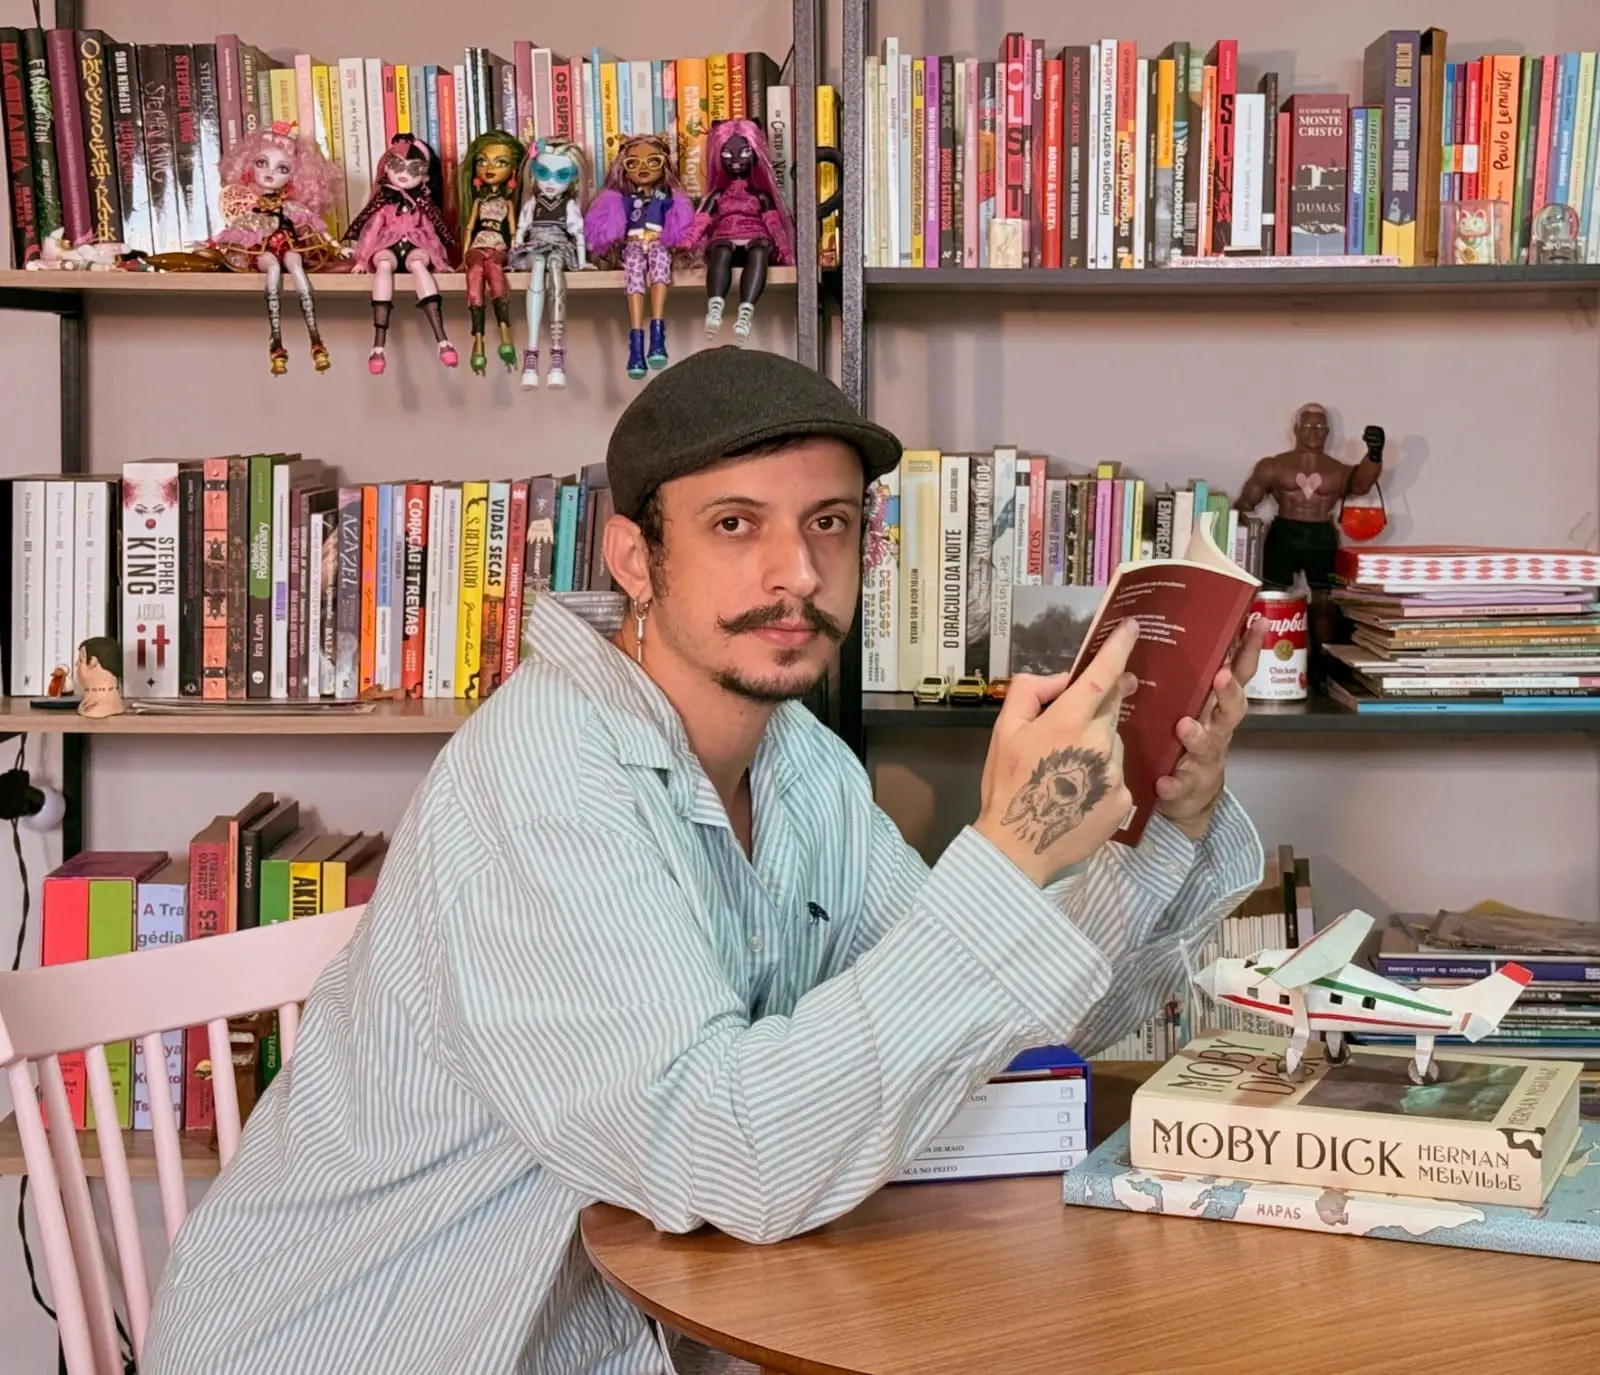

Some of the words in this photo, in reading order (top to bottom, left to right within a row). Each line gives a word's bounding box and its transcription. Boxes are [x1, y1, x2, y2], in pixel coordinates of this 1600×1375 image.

[115, 51, 127, 73] KING
[1103, 47, 1115, 91] uketsu
[117, 74, 132, 115] STEPHEN
[176, 55, 192, 108] STEPHEN
[555, 72, 569, 92] OS
[714, 83, 725, 91] O
[984, 77, 992, 97] ROSA
[1496, 69, 1513, 125] Leminski
[28, 58, 53, 144] FRANKENSTEIN
[144, 83, 168, 139] STEPHEN
[178, 112, 194, 143] KING
[1101, 93, 1114, 158] estranhas
[1298, 126, 1342, 137] CRISTO
[1299, 115, 1342, 126] MONTE
[150, 143, 171, 183] KING
[941, 148, 952, 182] SONHOS
[1046, 146, 1057, 181] ROMEU
[1119, 139, 1131, 175] NELSON
[1173, 139, 1186, 179] NELSON
[1492, 128, 1511, 170] Paulo
[1070, 193, 1080, 216] MARIA
[1099, 160, 1112, 216] imagens
[1045, 192, 1057, 231] JULIETA
[1118, 176, 1131, 237] RODRIGUES
[1172, 181, 1186, 238] RODRIGUES
[1296, 203, 1341, 213] DUMAS
[23, 492, 33, 510] Elena
[55, 492, 64, 510] Elena
[975, 465, 991, 504] DONNA
[23, 511, 32, 539] Ferrante
[55, 511, 64, 538] Ferrante
[405, 497, 425, 563] CORAÇÃO
[489, 499, 505, 542] VIDAS
[974, 506, 990, 559] HARAWAY
[1154, 500, 1173, 560] EMPRECA
[256, 521, 271, 582] Rosemary
[339, 513, 360, 589] AZAZEL
[463, 527, 479, 588] BERNARDO
[943, 529, 960, 562] NOITE
[1029, 530, 1041, 575] MITOS
[24, 556, 32, 583] História
[126, 536, 157, 596] KING
[158, 536, 176, 596] STEPHEN
[487, 545, 503, 586] SECAS
[509, 562, 520, 597] HOMEM
[943, 564, 960, 581] DA
[998, 555, 1010, 573] Ser
[405, 572, 421, 635] TREVAS
[879, 569, 892, 638] DEVASSOS
[909, 568, 919, 605] MITOLOGIA
[136, 604, 143, 621] A
[143, 604, 166, 621] COISA
[254, 613, 265, 641] Levin
[505, 607, 517, 647] CASTELO
[863, 592, 879, 649] PARAÍSO
[910, 606, 918, 619] DOS
[943, 583, 961, 638] ORÁCULO
[136, 623, 171, 671] it
[255, 642, 265, 657] Ira
[504, 648, 515, 674] ALTO
[943, 639, 961, 649] O
[1269, 666, 1297, 675] Chicken
[1270, 677, 1297, 685] Gumbo
[143, 902, 156, 917] A
[157, 902, 185, 917] Tra
[291, 876, 319, 920] AKIR
[137, 930, 183, 949] gédia
[267, 1034, 277, 1069] TEATRO
[1168, 1038, 1265, 1093] MOBY
[944, 1145, 964, 1153] MAIO
[1151, 1118, 1281, 1166] MOBY
[1296, 1132, 1406, 1179] DICK
[1417, 1144, 1510, 1169] HERMAN
[919, 1166, 931, 1174] NO
[932, 1165, 957, 1173] PEITO
[1417, 1166, 1522, 1192] MELVILLE
